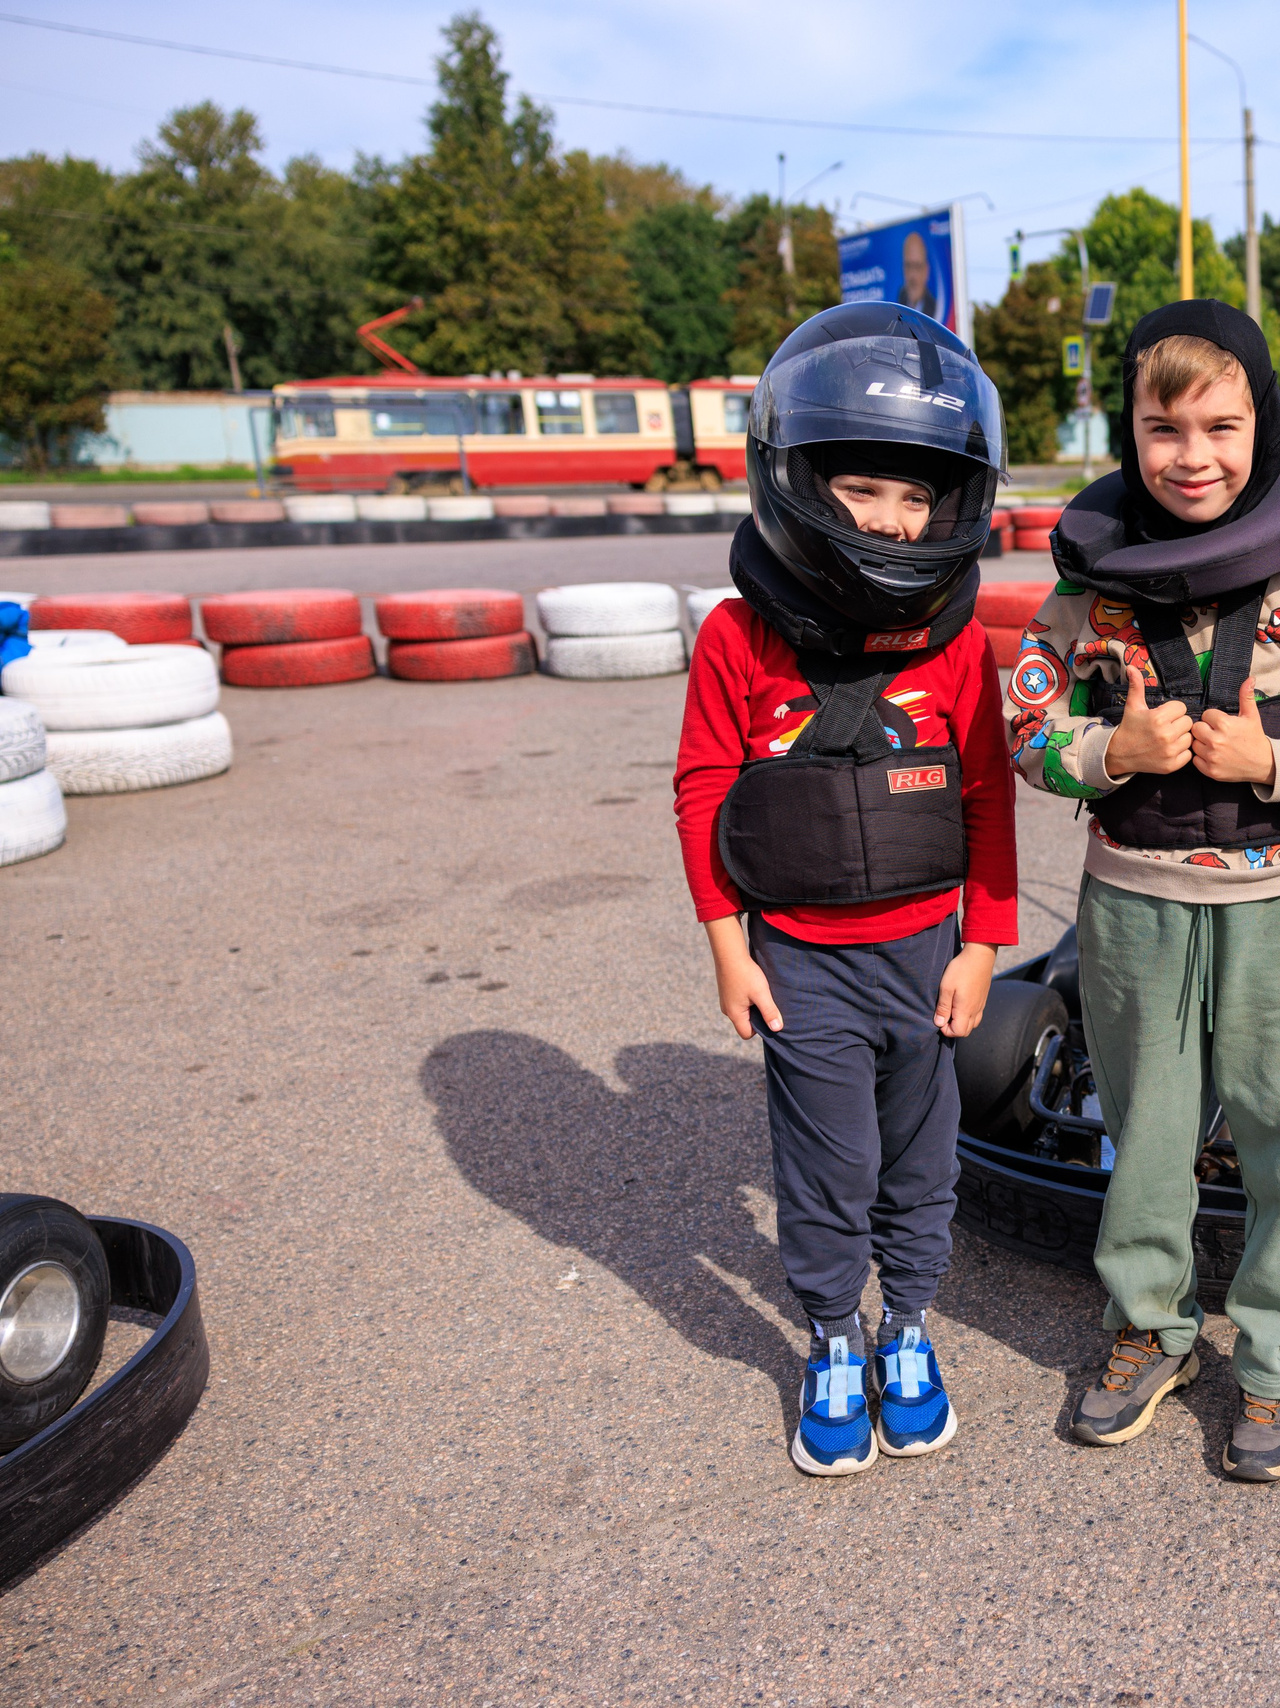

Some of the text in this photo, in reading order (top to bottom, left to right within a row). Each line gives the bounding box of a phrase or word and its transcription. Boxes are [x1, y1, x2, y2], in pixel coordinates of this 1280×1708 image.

[866, 382, 965, 412] LS2
[871, 632, 925, 645] RLG
[896, 770, 941, 788] RLG
